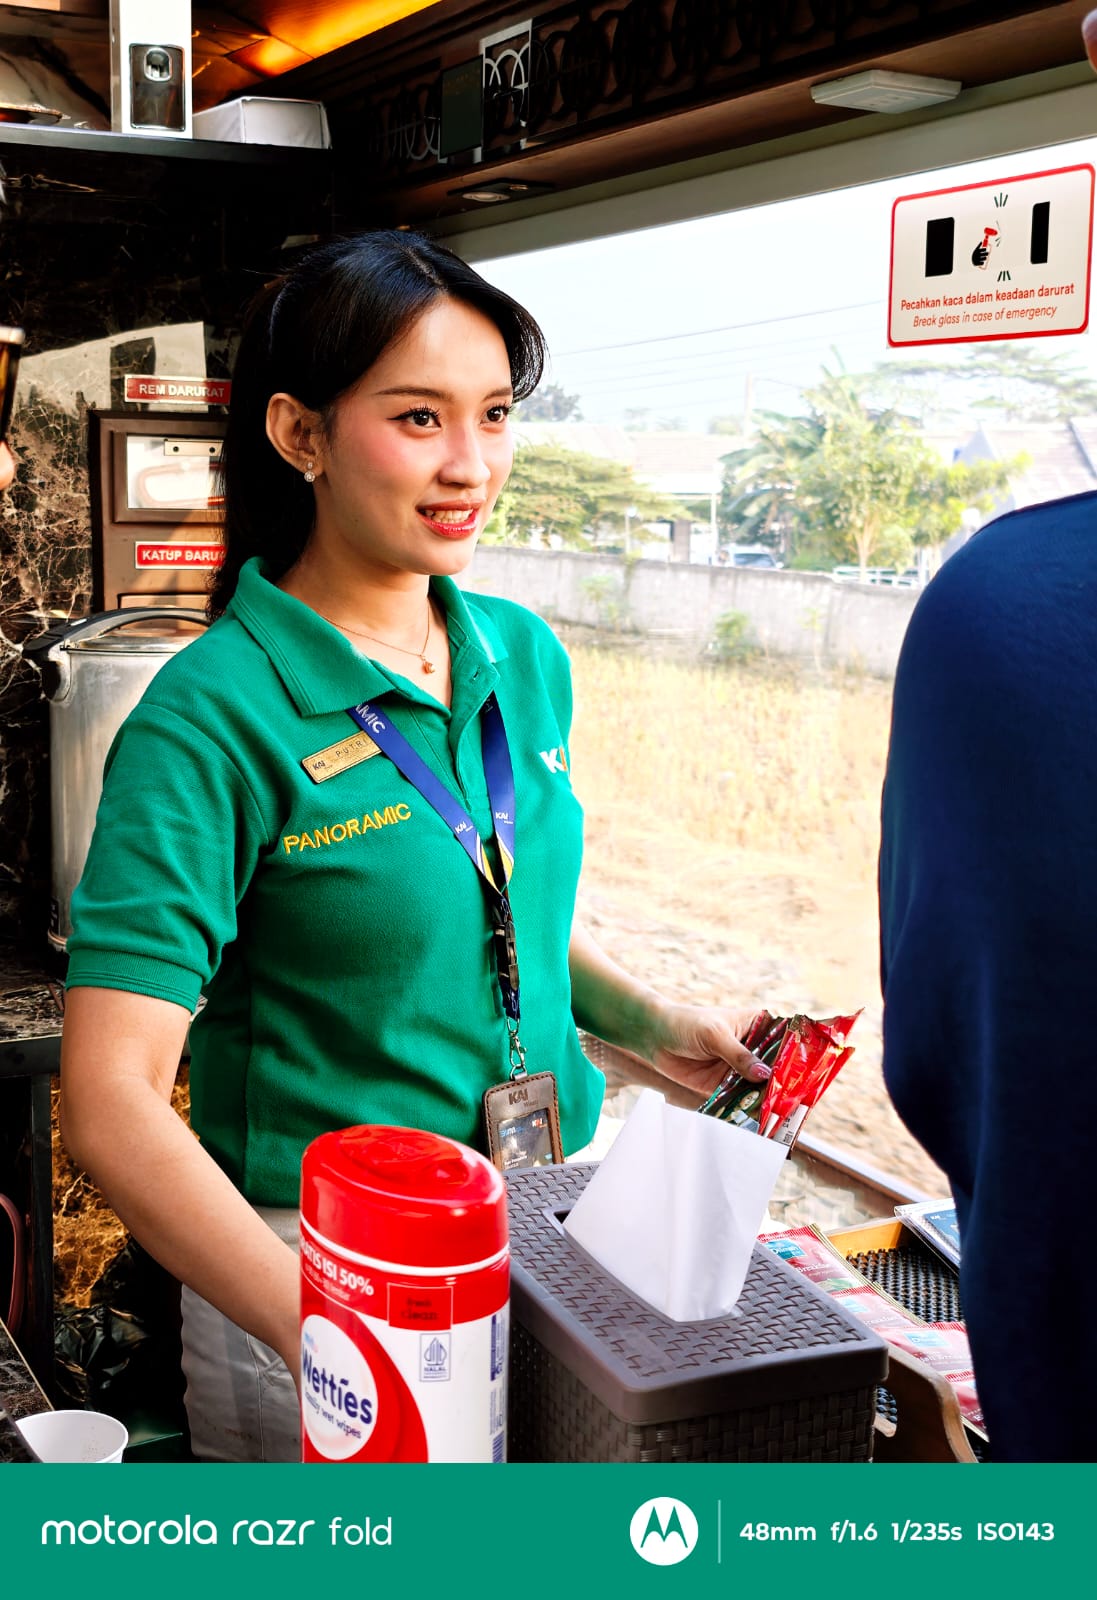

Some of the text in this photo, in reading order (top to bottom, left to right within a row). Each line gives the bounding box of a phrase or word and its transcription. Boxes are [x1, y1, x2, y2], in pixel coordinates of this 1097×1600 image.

[901, 283, 1075, 310] Pecahkan kaca dalam keadaan darurat
[913, 305, 1058, 328] Break glass in case of emergency
[139, 384, 224, 397] REM DARURAT
[142, 549, 222, 561] KATUP DARU
[335, 738, 368, 757] PUTRI
[283, 803, 411, 854] PANORAMIC
[508, 1088, 528, 1105] KAI
[322, 1257, 337, 1281] ISI
[339, 1267, 374, 1296] 50%
[302, 1343, 373, 1425] Wetties
[336, 1419, 362, 1439] wipes
